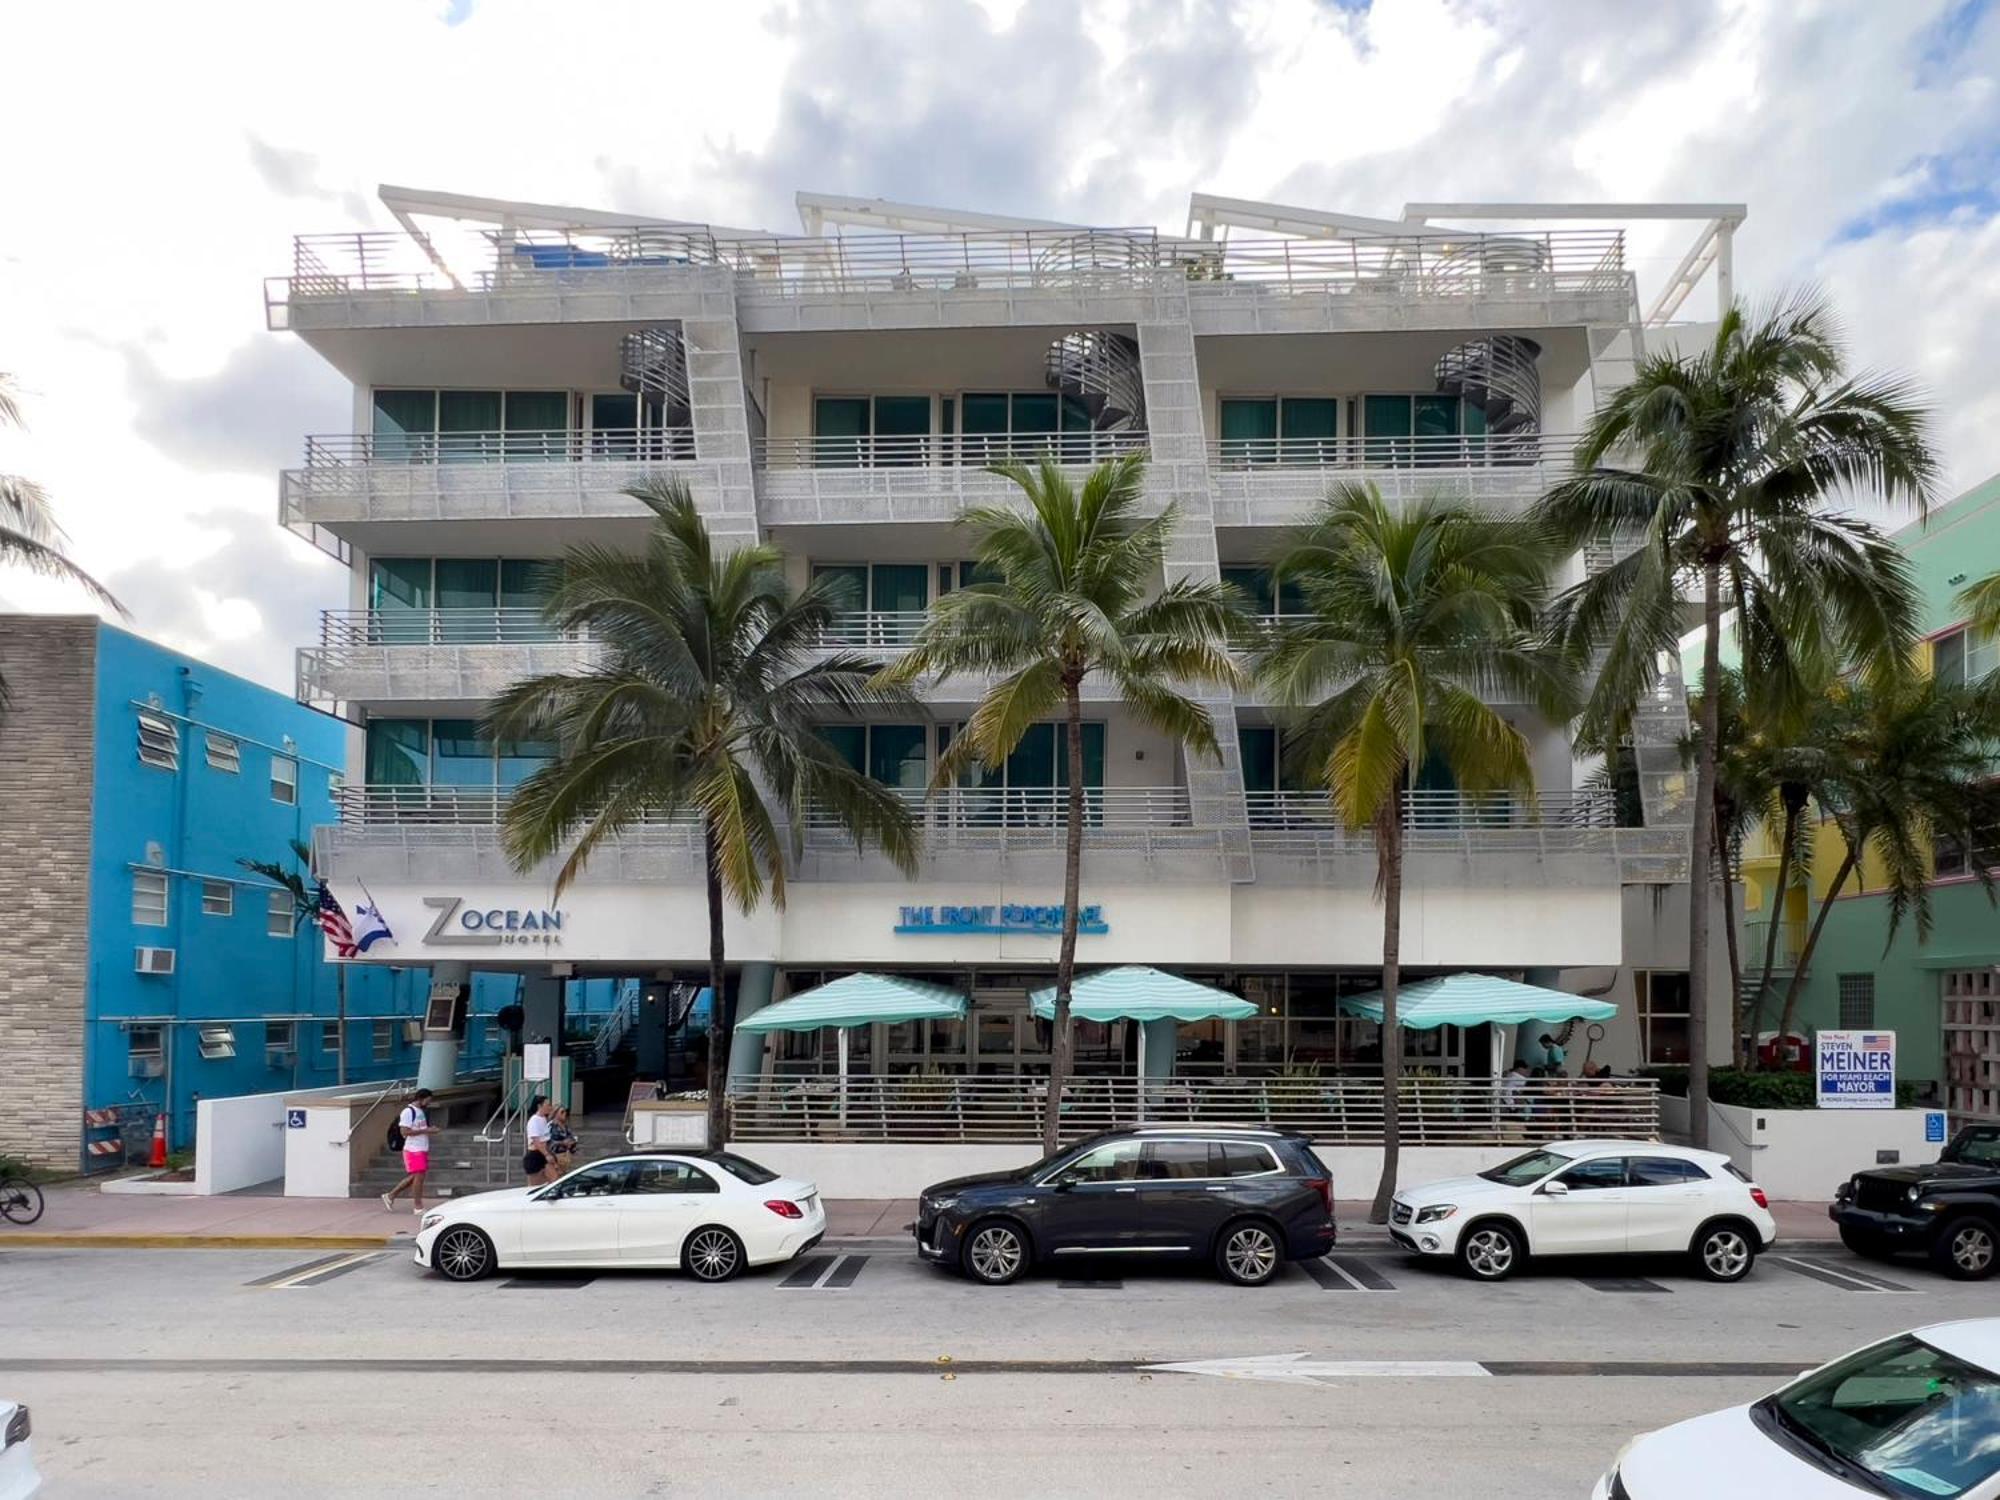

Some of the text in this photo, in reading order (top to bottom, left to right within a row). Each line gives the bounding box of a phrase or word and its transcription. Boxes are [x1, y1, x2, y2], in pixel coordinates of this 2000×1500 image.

[899, 906, 934, 925] THE
[940, 906, 996, 925] FRONT
[422, 897, 561, 946] Z OCEAN
[503, 934, 561, 945] HOTEL
[1821, 1042, 1853, 1051] STEVEN
[1821, 1052, 1891, 1070] MEINER
[1822, 1073, 1889, 1081] FOR MIAMI BEACH
[1837, 1082, 1876, 1092] MAYOR
